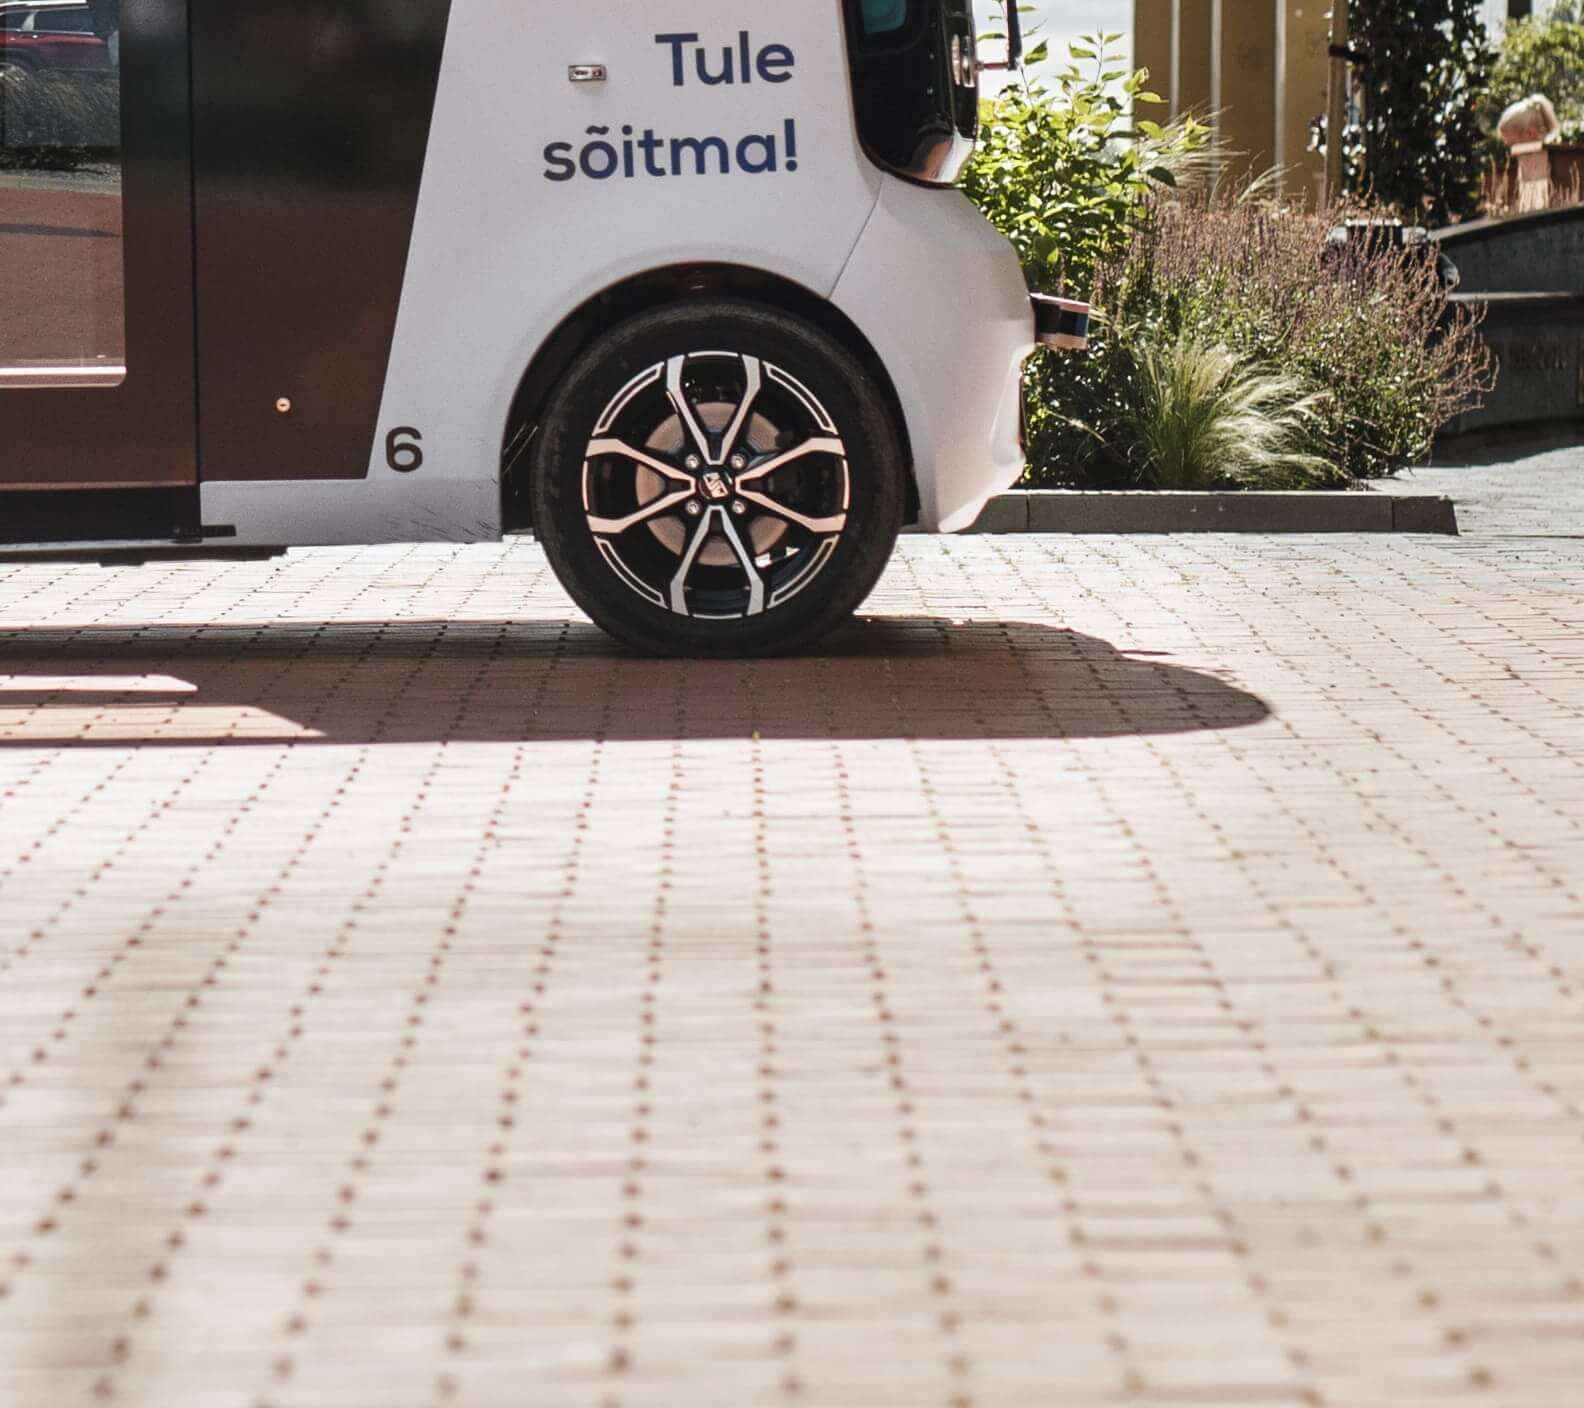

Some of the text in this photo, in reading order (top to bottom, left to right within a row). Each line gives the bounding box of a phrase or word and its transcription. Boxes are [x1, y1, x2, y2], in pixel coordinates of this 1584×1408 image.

[655, 31, 795, 86] Tule
[543, 118, 798, 182] sõitma!
[385, 426, 424, 474] 6
